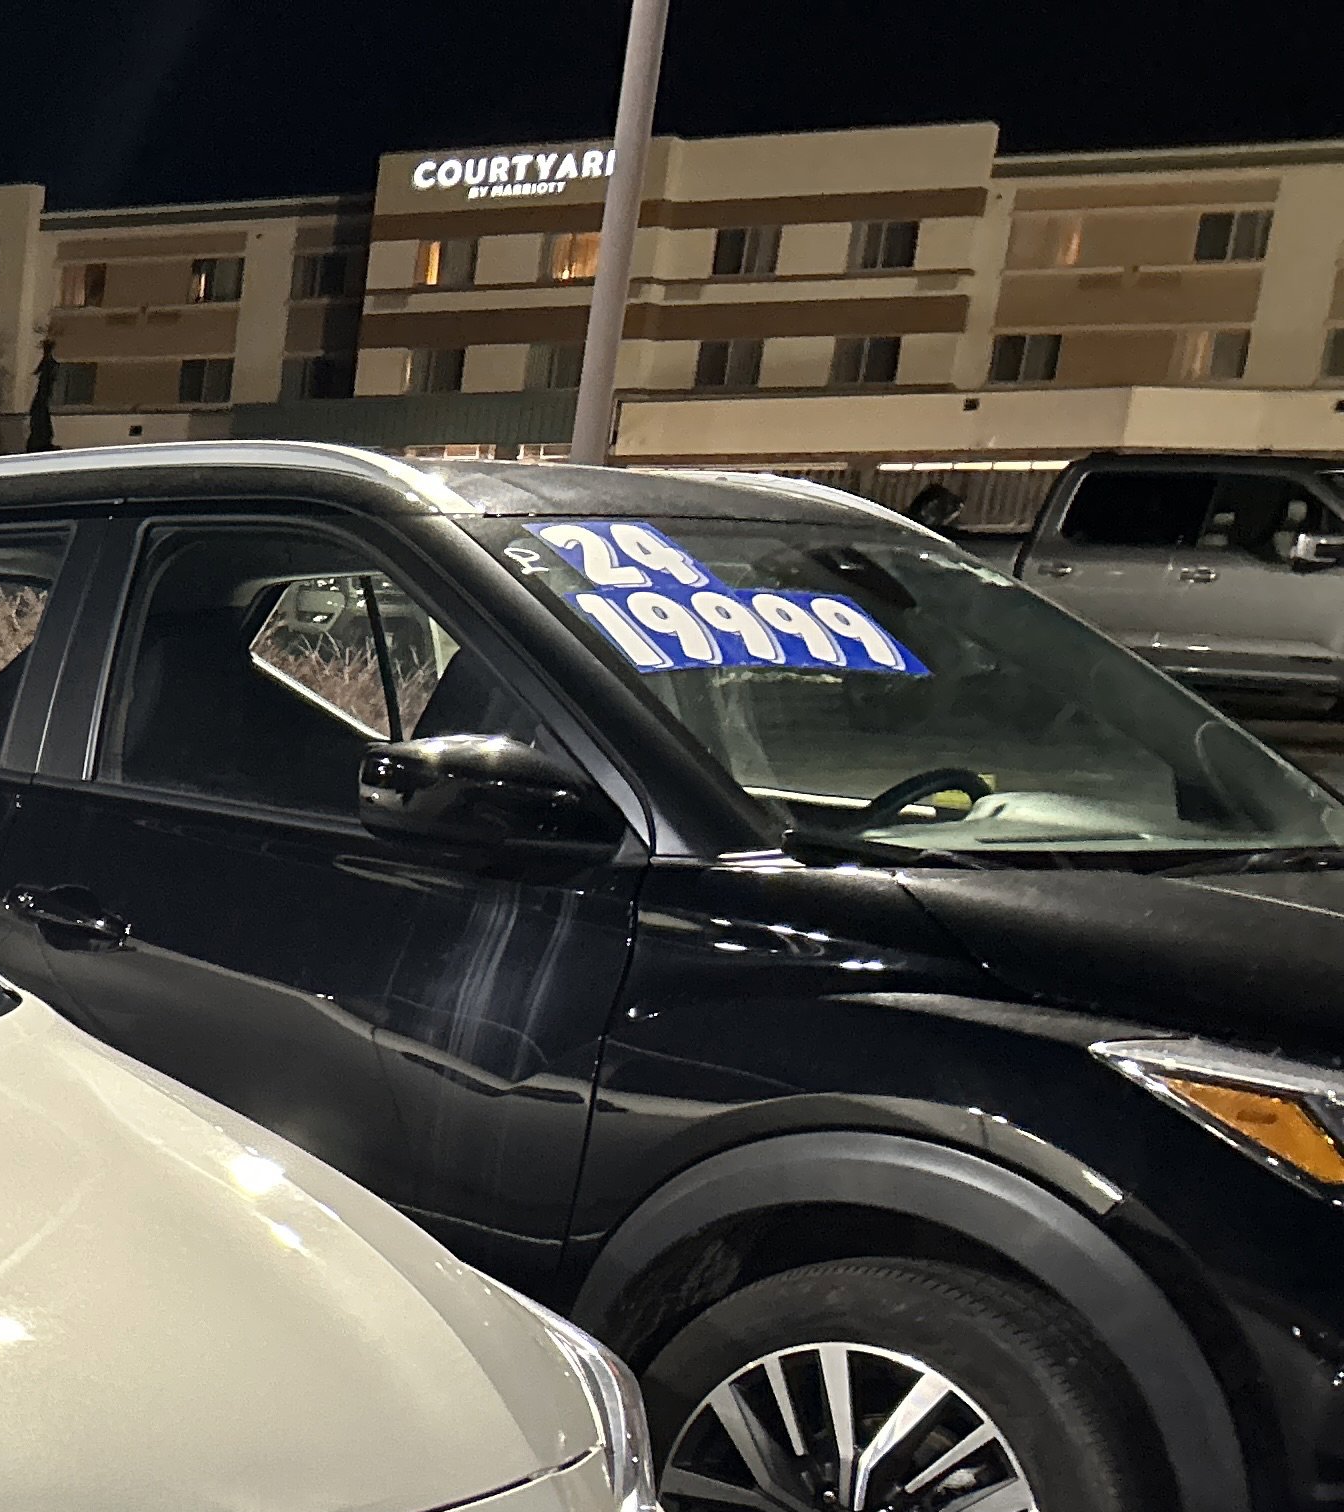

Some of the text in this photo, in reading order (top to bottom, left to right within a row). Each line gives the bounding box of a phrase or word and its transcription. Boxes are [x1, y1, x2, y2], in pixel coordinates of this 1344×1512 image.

[467, 181, 567, 199] BY MARRIOTT
[539, 523, 709, 589] 24
[576, 591, 906, 670] 19999
